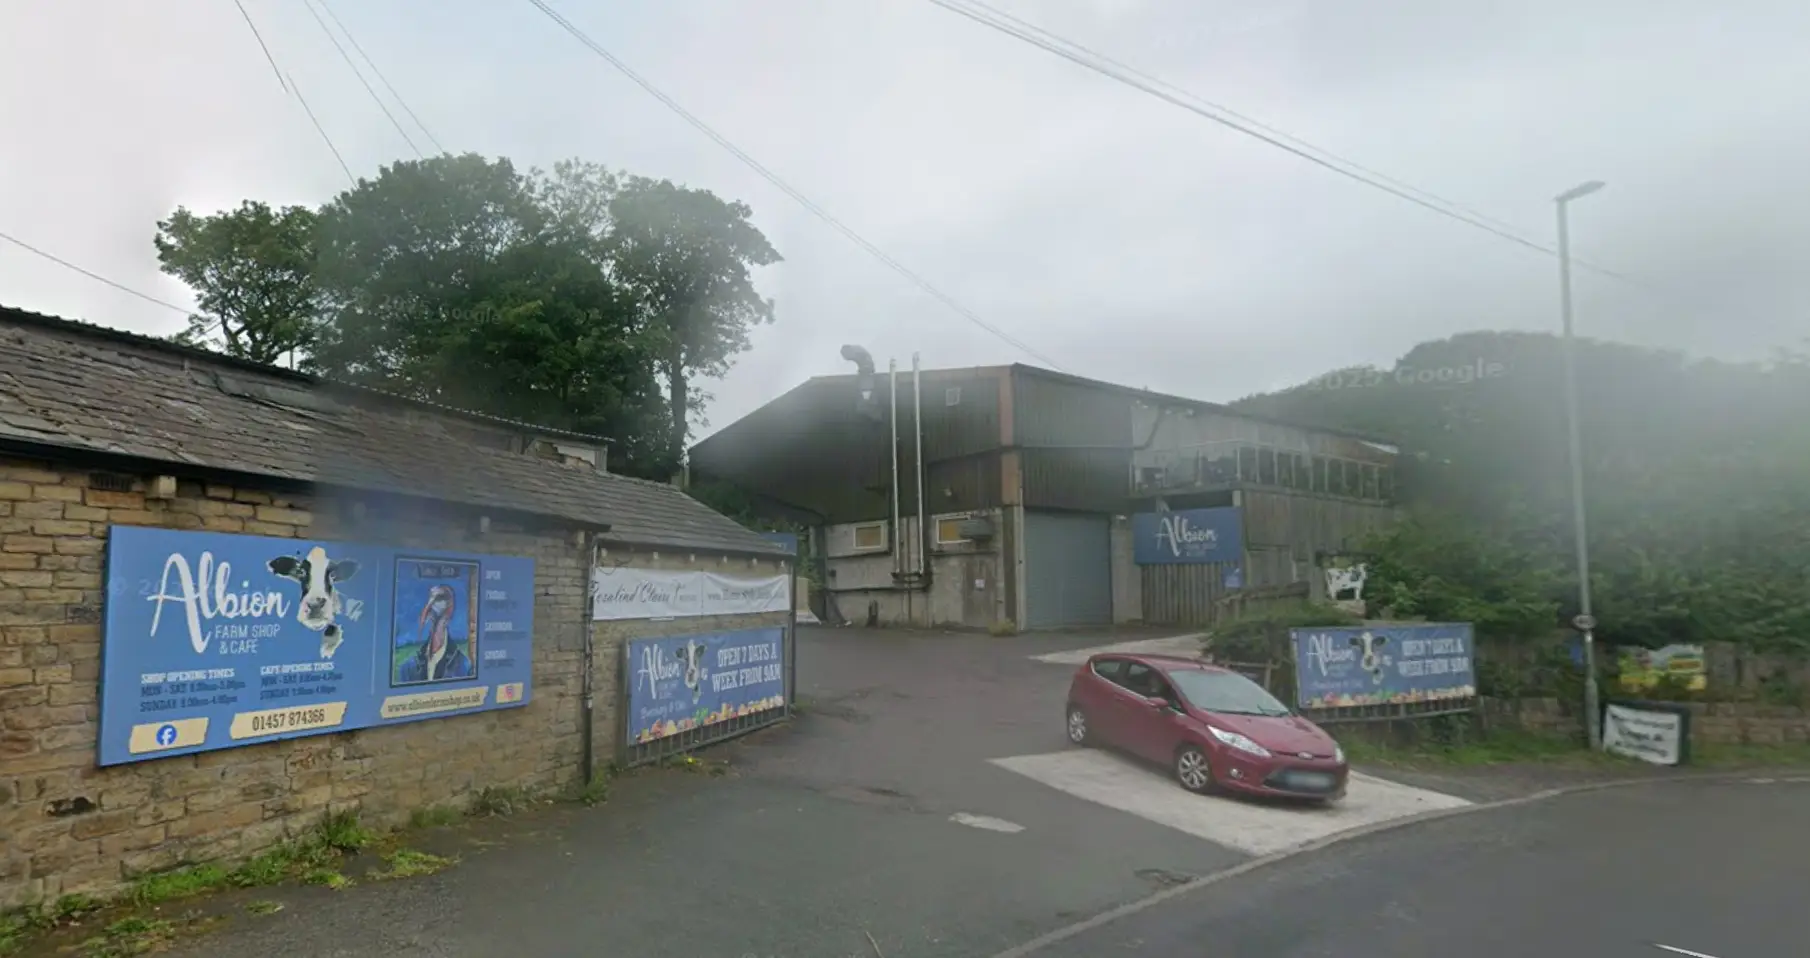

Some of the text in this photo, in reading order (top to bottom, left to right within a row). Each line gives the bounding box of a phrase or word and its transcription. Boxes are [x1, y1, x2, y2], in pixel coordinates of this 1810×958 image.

[1155, 515, 1219, 557] Albion
[146, 550, 290, 654] Albion
[215, 623, 281, 640] FARM SHOP
[219, 641, 228, 655] &
[717, 642, 778, 667] OPEN 7 DAYS A
[1306, 633, 1356, 677] Albion
[637, 644, 682, 699] Albion
[712, 663, 781, 692] WEEK FROM 9AM
[140, 699, 178, 713] SUNDAY
[251, 708, 325, 732] 01457 874366
